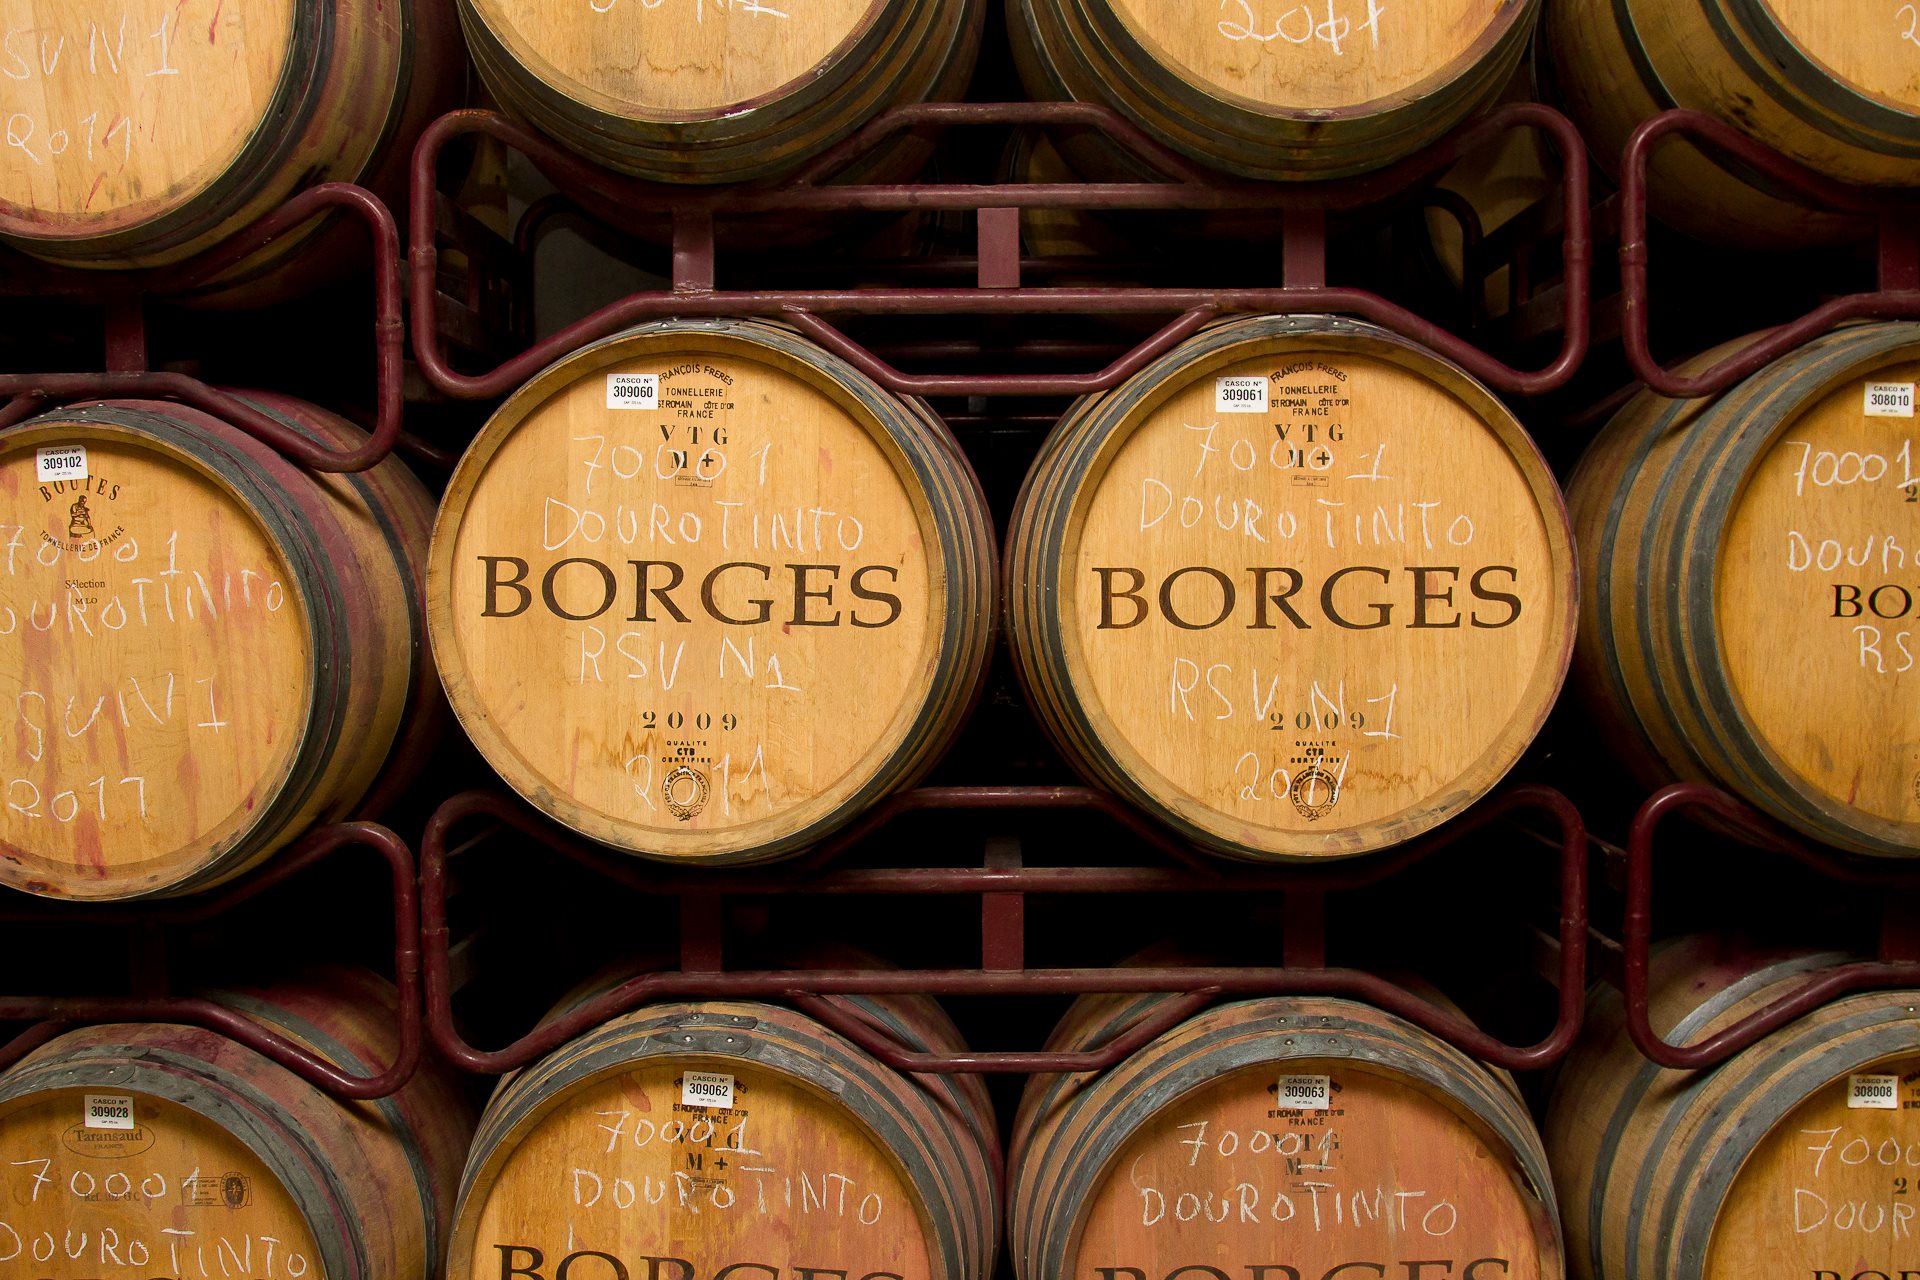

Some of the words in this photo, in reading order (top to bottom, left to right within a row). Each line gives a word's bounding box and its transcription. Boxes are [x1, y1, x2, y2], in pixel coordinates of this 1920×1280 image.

[659, 363, 701, 384] FRANÇOIS
[1270, 361, 1314, 384] FRANÇOIS
[1316, 362, 1348, 383] FRERES
[613, 385, 653, 398] 309060
[666, 387, 724, 397] TONNELLERIE
[1222, 388, 1262, 401] 309061
[1280, 385, 1338, 395] TONNELLERIE
[1871, 393, 1909, 406] 308010
[665, 399, 693, 409] ROMAIN
[1280, 399, 1307, 408] ROMAIN
[1292, 407, 1329, 416] FRANCE
[677, 409, 714, 419] FRANCE
[45, 448, 70, 456] CASCO
[43, 456, 82, 470] 309102
[1786, 439, 1920, 497] 70001
[39, 474, 120, 503] BOUTES
[1140, 478, 1297, 543] DOURO
[1317, 499, 1474, 549] TINTO
[542, 496, 701, 551] DOURO
[713, 501, 863, 553] TINTO
[99, 525, 125, 548] FRANCE
[1787, 531, 1920, 575] DOUR
[65, 579, 106, 589] Sélection
[477, 556, 903, 628] BORGES
[131, 569, 284, 626] TINTO
[1091, 566, 1523, 630] BORGES
[1830, 584, 1920, 619] BO
[580, 626, 686, 691] RSV
[1171, 657, 1279, 721] RSV
[642, 711, 737, 731] 2009
[1269, 711, 1365, 731] 2009
[677, 747, 695, 756] CTB
[8, 776, 147, 823] 2017
[692, 1075, 717, 1083] CASCO
[689, 1083, 728, 1097] 309062
[1284, 1086, 1324, 1098] 309063
[1854, 1085, 1893, 1097] 308008
[91, 1106, 128, 1118] 309028
[692, 1113, 728, 1124] FRANCE
[1288, 1117, 1325, 1127] FRANCE
[74, 1129, 143, 1142] Taransaud
[594, 1111, 761, 1155] 70001
[686, 1152, 702, 1170] M
[11, 1159, 200, 1202] 70001
[738, 1165, 883, 1226] TINTO
[1142, 1182, 1296, 1227] DOURO
[1303, 1181, 1457, 1236] TINTO
[161, 1228, 307, 1279] TINTO
